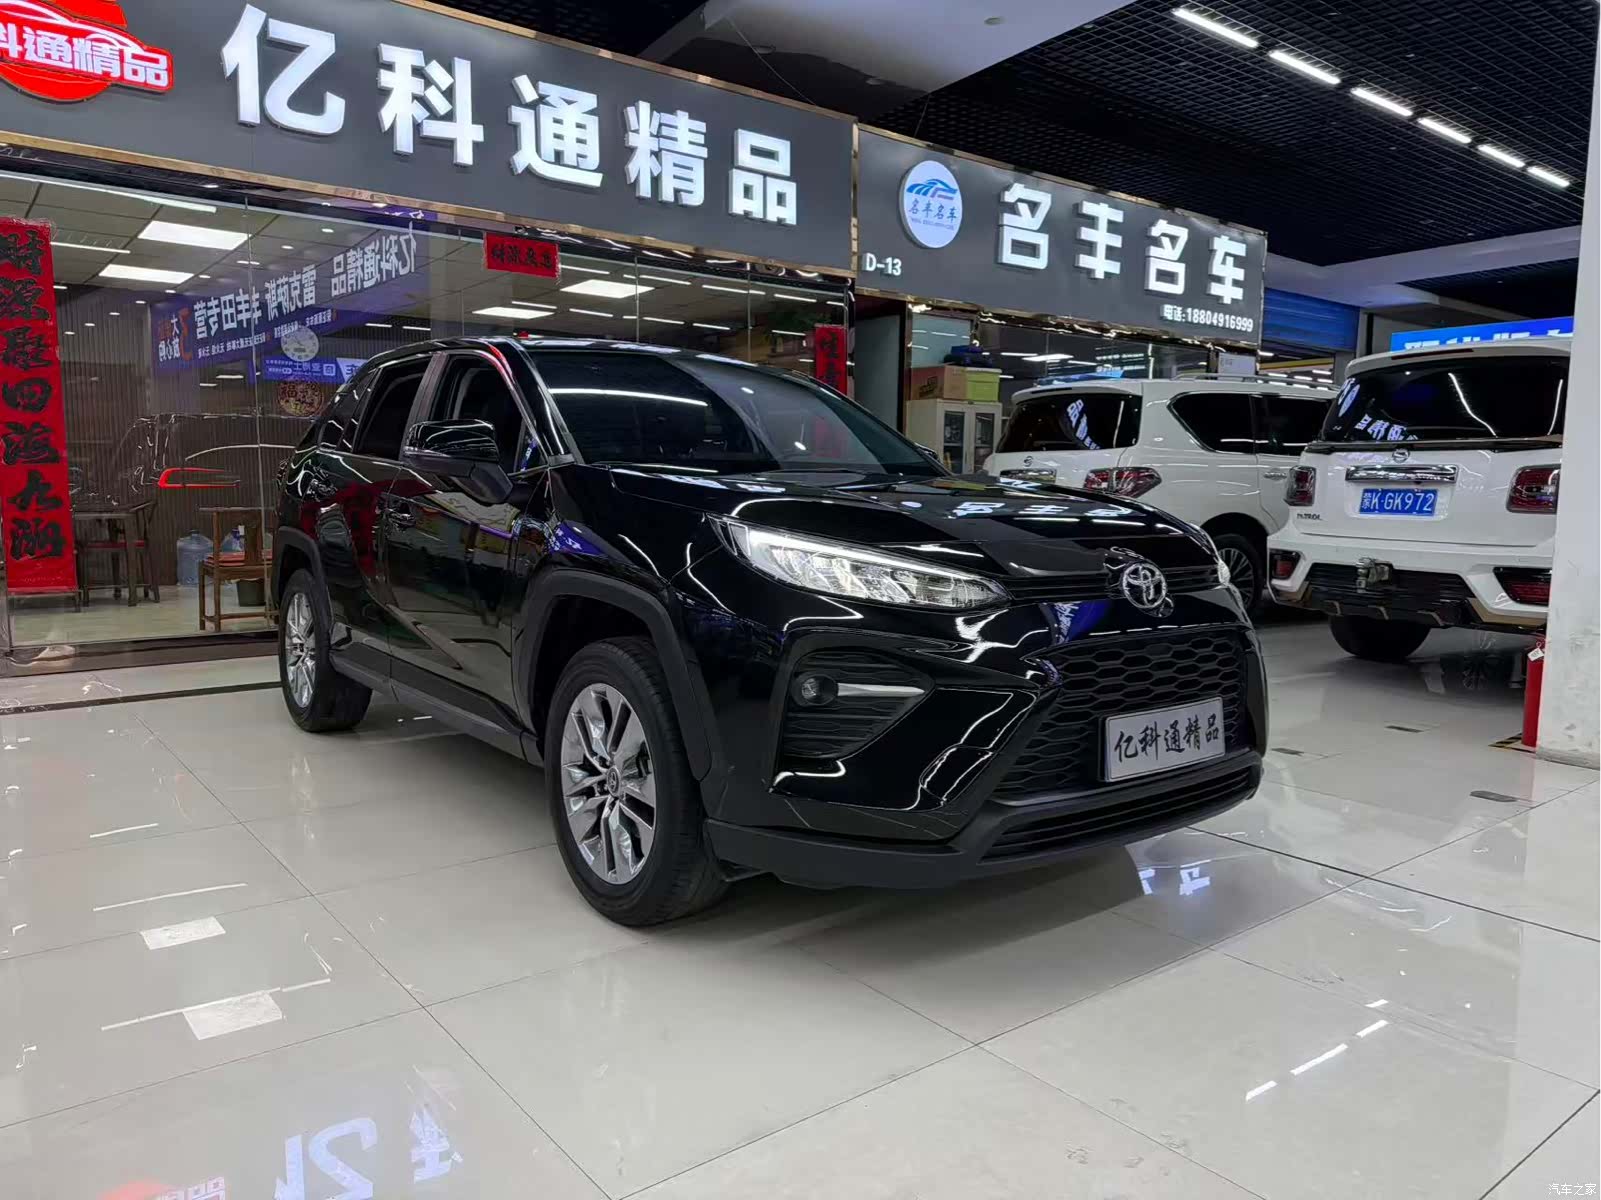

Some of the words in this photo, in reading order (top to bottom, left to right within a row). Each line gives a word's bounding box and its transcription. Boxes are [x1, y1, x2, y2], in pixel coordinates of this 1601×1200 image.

[220, 3, 798, 226] 亿科通精品
[909, 198, 957, 223] 名丰名车
[1000, 182, 1247, 305] 名丰名车
[864, 252, 902, 276] D-13
[1162, 304, 1254, 333] 电话:18804916999
[1114, 712, 1220, 763] 亿科通精品
